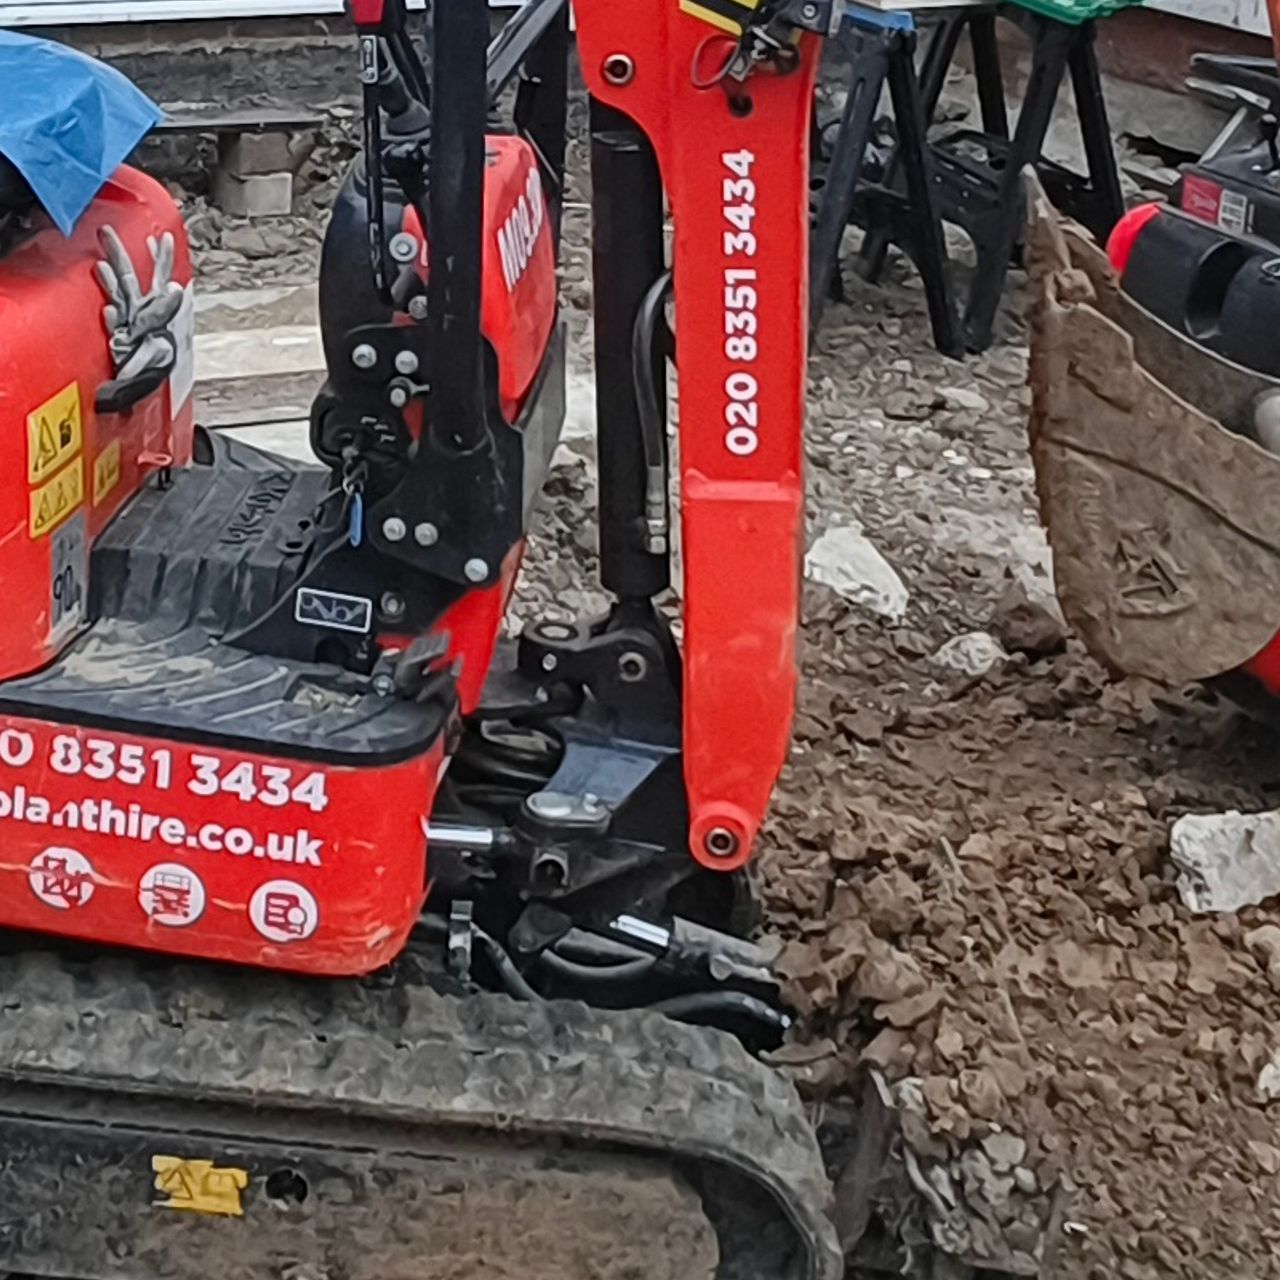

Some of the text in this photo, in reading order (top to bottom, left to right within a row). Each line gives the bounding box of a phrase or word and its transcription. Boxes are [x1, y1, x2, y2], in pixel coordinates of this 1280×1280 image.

[722, 149, 758, 456] 020 8351 3434
[50, 733, 171, 790] 8351
[187, 753, 329, 813] 3434
